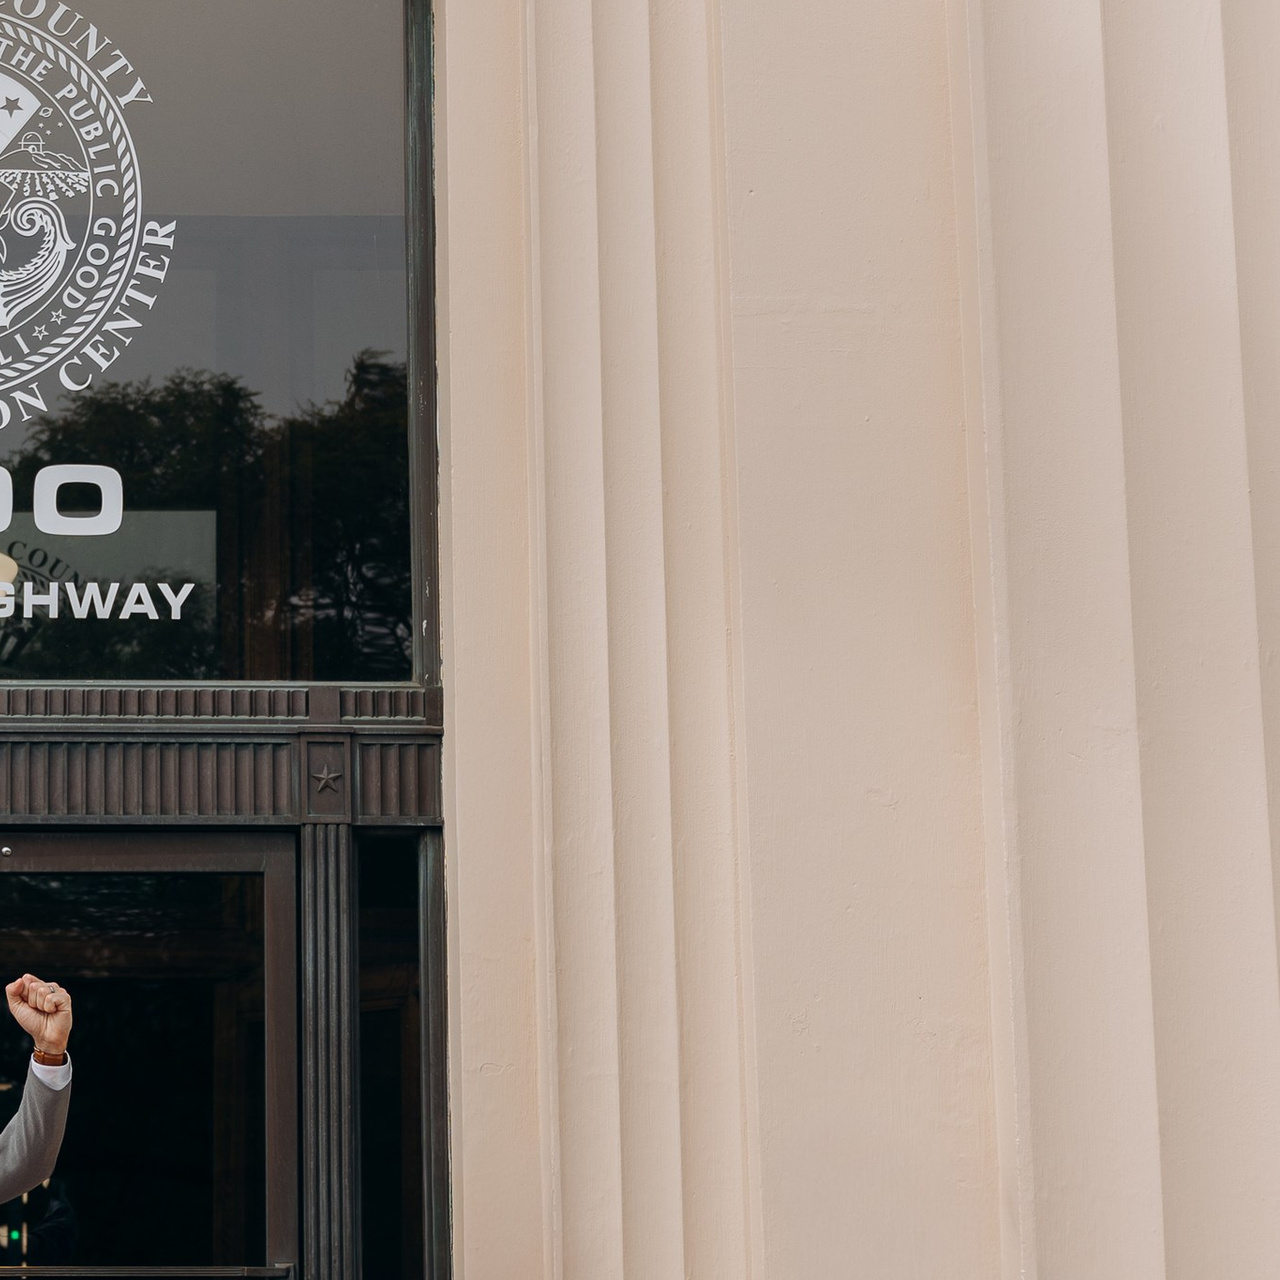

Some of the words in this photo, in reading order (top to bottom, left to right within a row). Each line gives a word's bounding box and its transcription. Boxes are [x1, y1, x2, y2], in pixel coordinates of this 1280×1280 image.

[54, 82, 119, 198] PUBLIC
[58, 219, 177, 392] CENTER
[61, 217, 117, 309] GOOD
